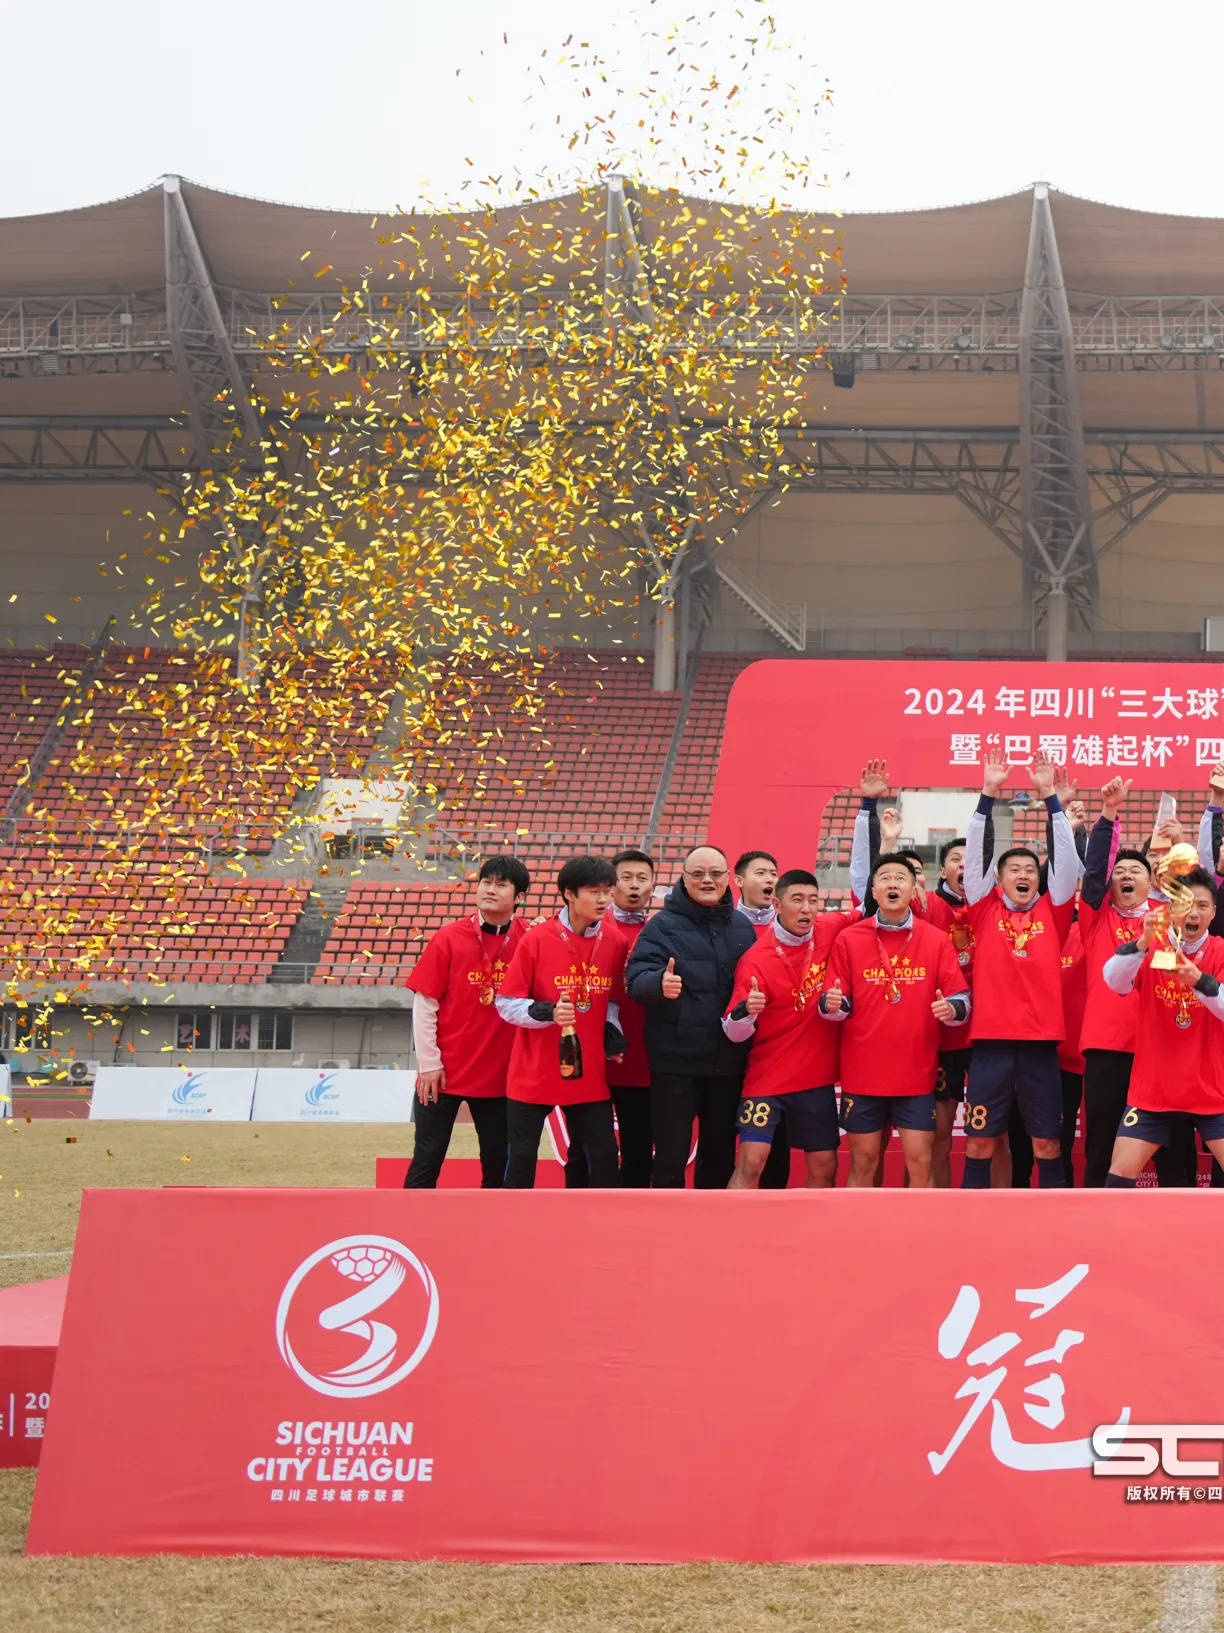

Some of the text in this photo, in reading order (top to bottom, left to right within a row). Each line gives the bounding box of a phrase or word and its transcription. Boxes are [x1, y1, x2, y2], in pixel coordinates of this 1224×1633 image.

[863, 967, 926, 979] CHAPIONS
[739, 1100, 771, 1128] 38
[276, 1421, 414, 1445] SICHUAN
[295, 1446, 389, 1456] FOOTBALL
[247, 1457, 434, 1482] CITY LEAGUE
[271, 1489, 405, 1502] 四川足球城市联赛
